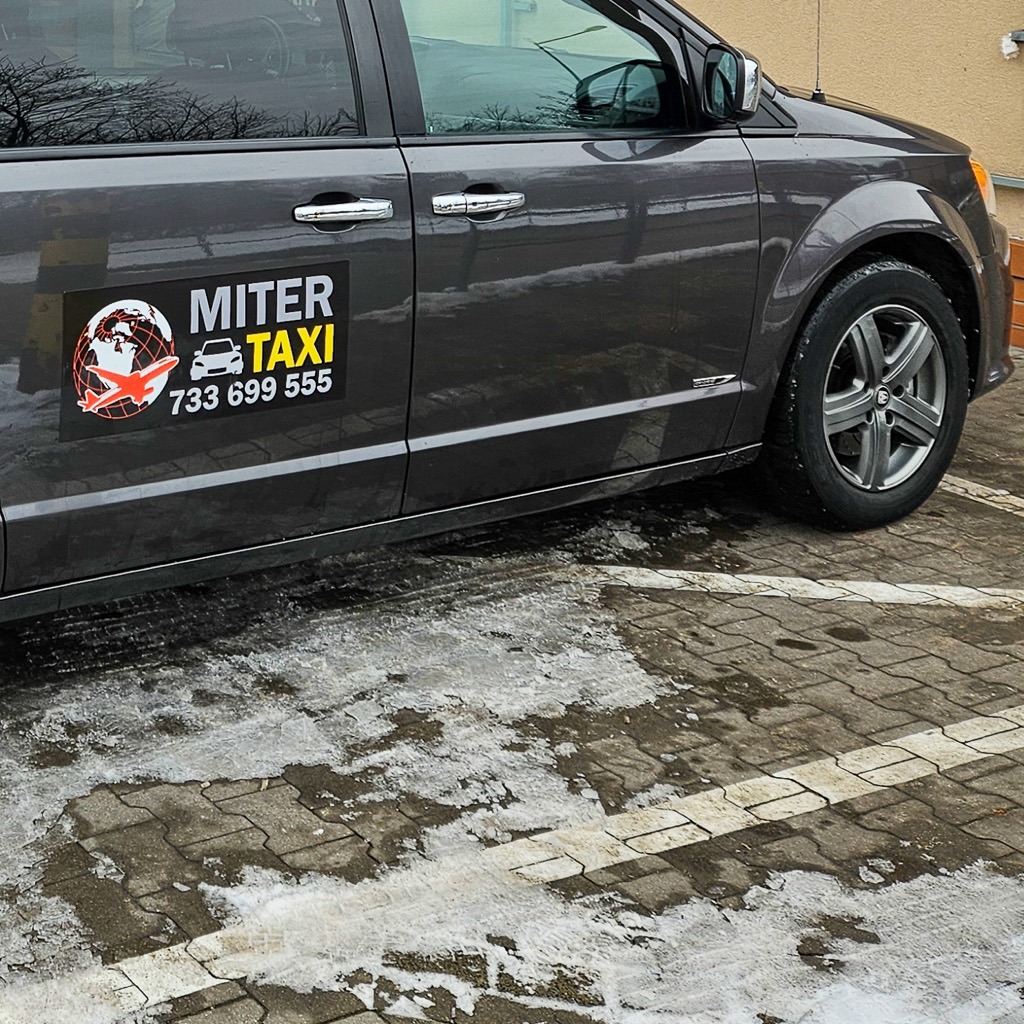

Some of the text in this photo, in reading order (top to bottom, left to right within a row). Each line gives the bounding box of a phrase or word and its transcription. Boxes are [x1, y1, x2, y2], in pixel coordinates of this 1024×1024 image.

[189, 274, 335, 334] MITER
[246, 323, 335, 374] TAXI
[169, 368, 333, 416] 733 699 555
